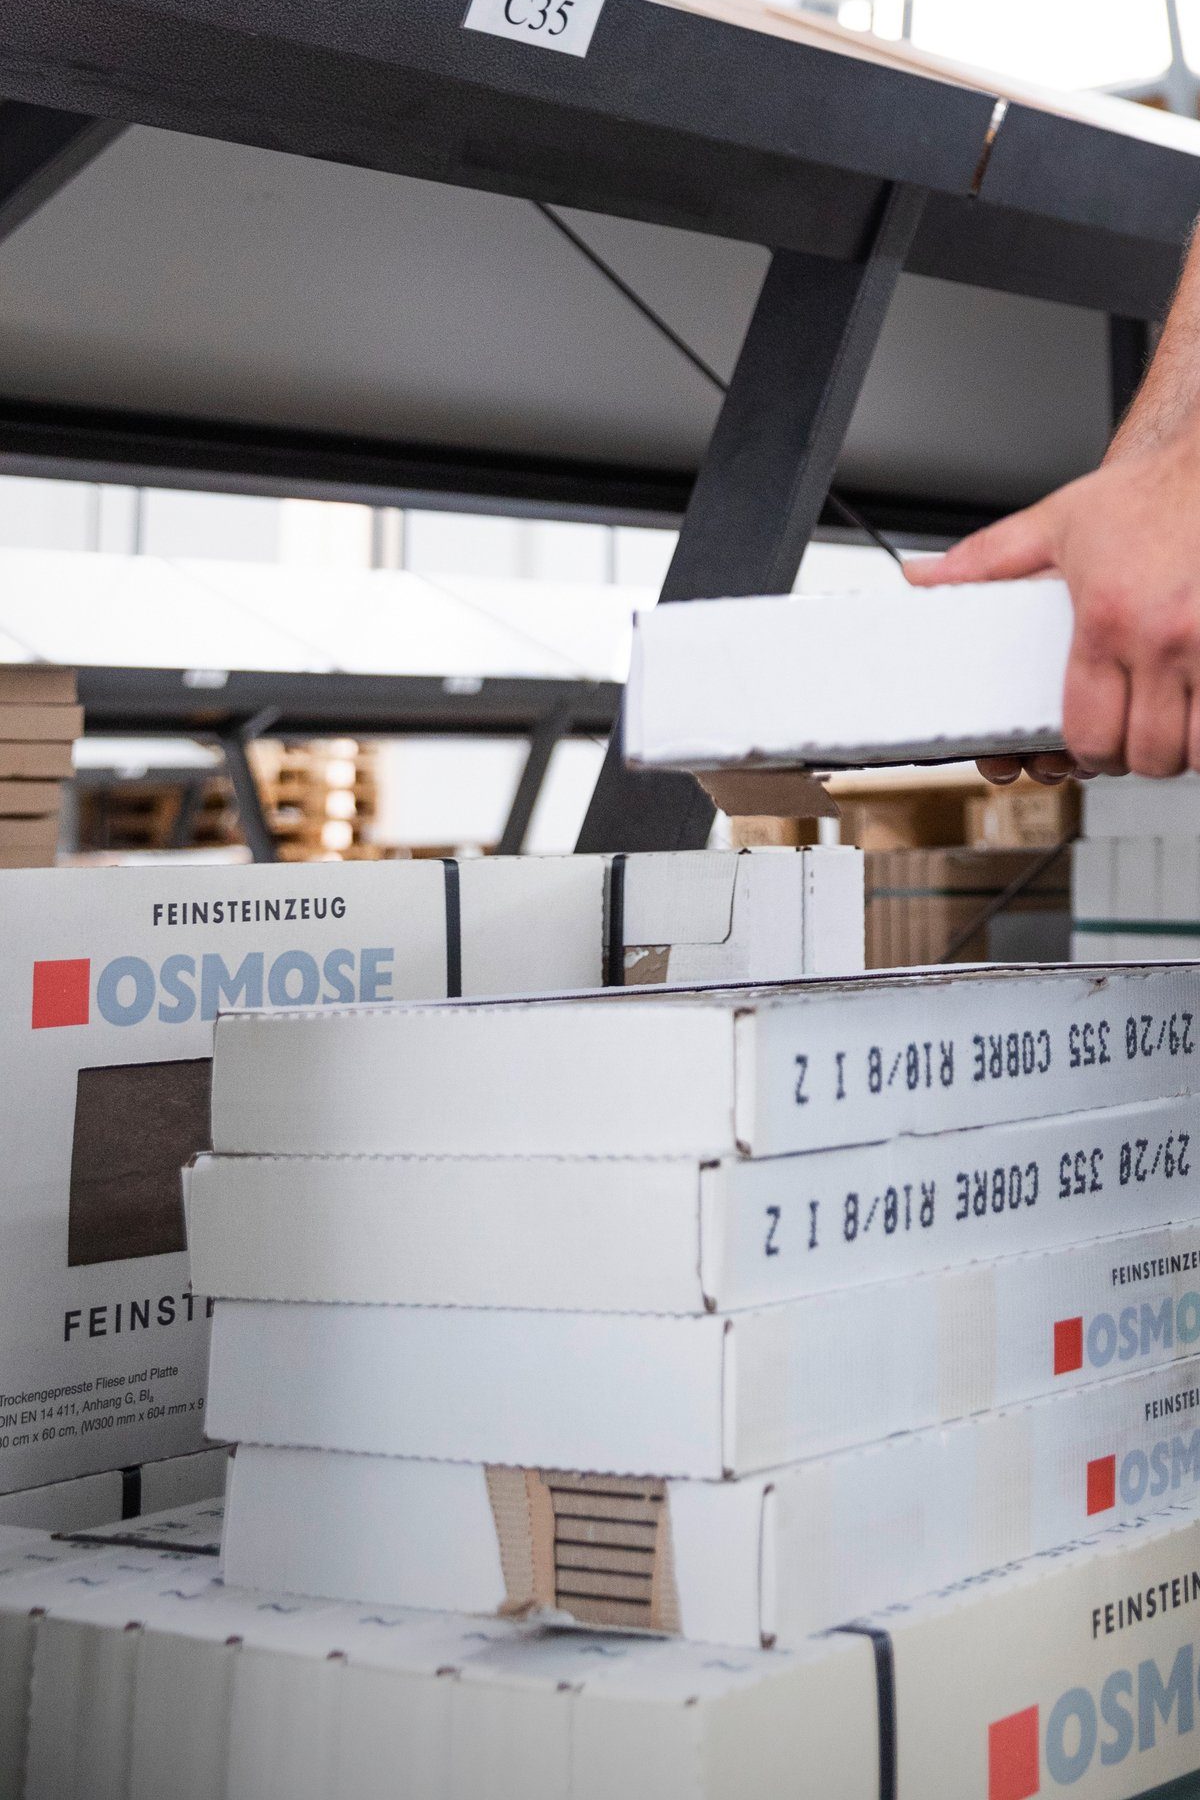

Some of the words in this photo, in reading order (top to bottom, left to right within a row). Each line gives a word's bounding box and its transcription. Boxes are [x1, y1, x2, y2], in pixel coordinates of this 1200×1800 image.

[152, 896, 347, 927] FEINSTEINZEUG
[96, 946, 395, 1028] OSMOSE
[971, 1028, 1052, 1083] COBRE
[1068, 1020, 1112, 1069] 355
[1124, 1010, 1196, 1058] 29/20
[1059, 1147, 1104, 1199] 355
[1118, 1131, 1192, 1184] 29/20
[954, 1161, 1041, 1222] COBRE
[0, 1380, 93, 1407] Trockengepresste
[96, 1375, 126, 1391] Fliese
[128, 1369, 148, 1384] und
[150, 1365, 179, 1380] Platte
[12, 1434, 30, 1447] cm
[33, 1432, 39, 1443] x
[42, 1426, 56, 1441] 60
[58, 1425, 78, 1438] cm,
[116, 1413, 136, 1426] mm
[139, 1412, 145, 1422] x
[147, 1404, 166, 1420] 604
[167, 1402, 187, 1416] mm
[189, 1401, 196, 1412] x
[21, 1409, 37, 1425] EN
[41, 1406, 54, 1420] 14
[56, 1402, 79, 1417] 411,
[82, 1397, 122, 1414] Anhang
